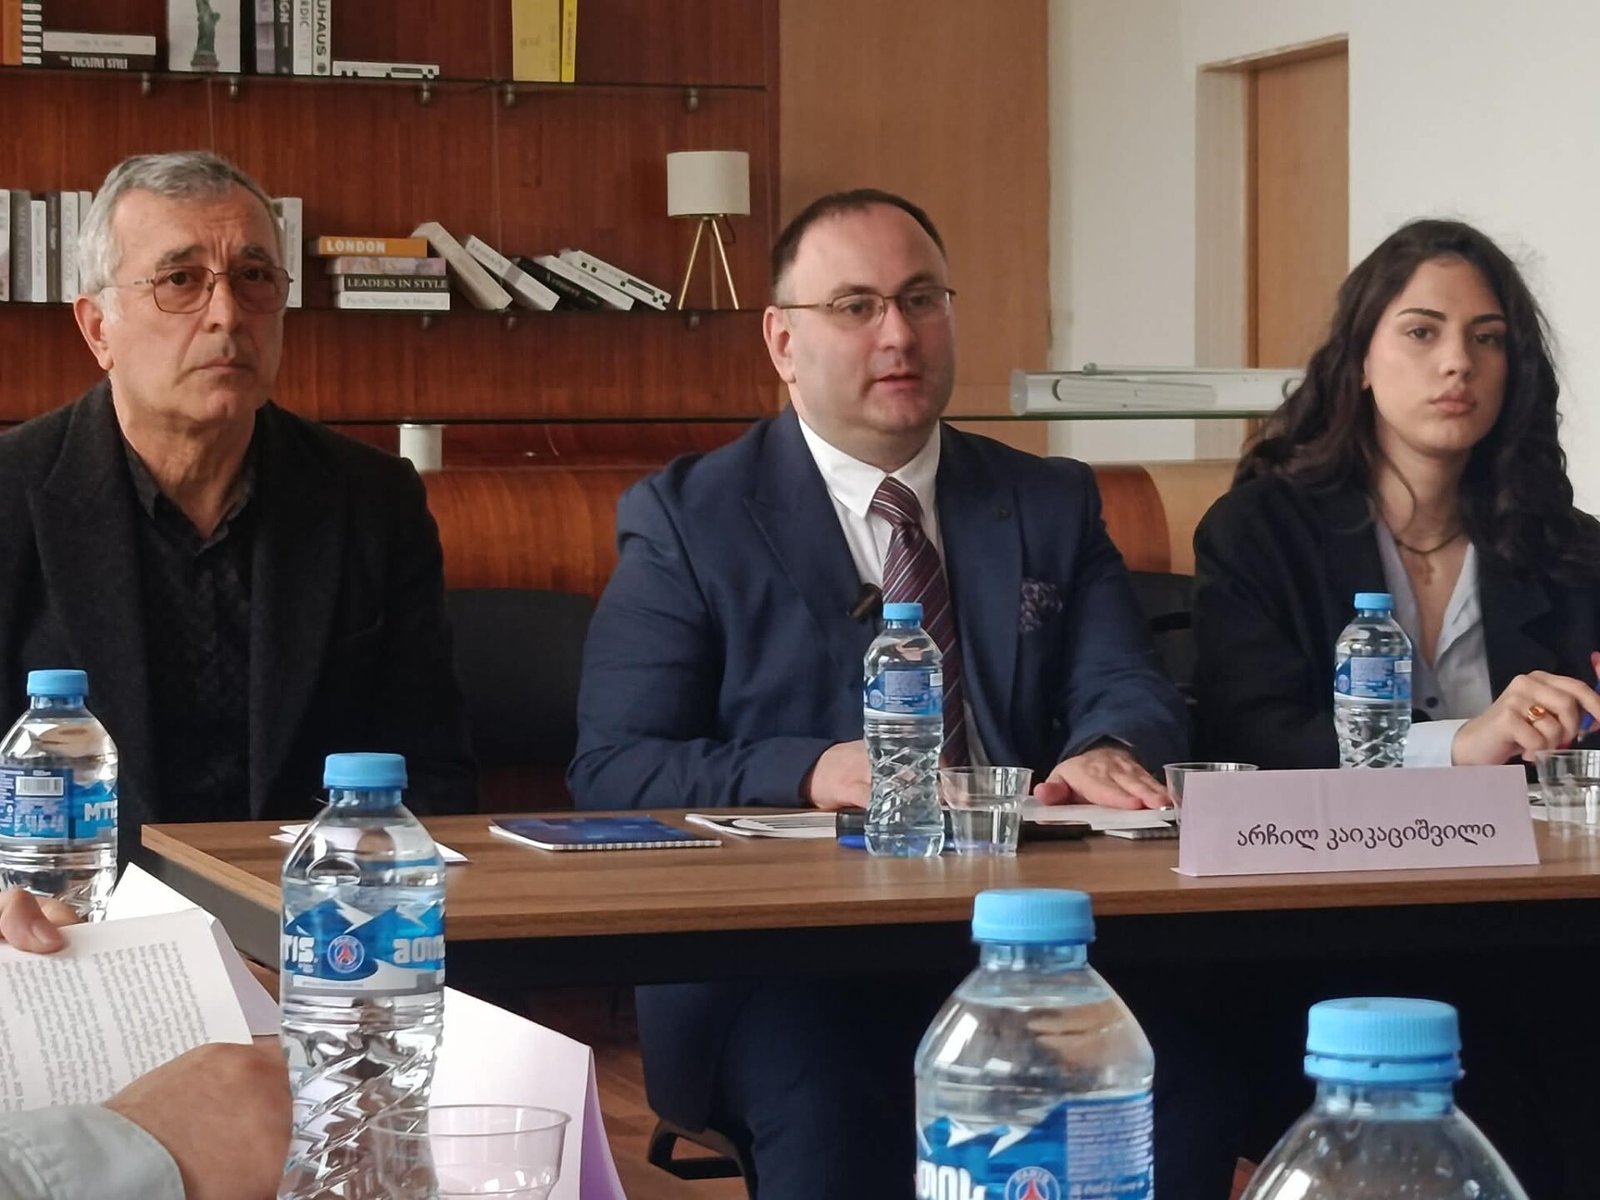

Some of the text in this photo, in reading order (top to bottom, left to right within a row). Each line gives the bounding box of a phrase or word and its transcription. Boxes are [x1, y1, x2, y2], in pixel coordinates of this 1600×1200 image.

[326, 240, 386, 254] LONDON
[347, 278, 447, 289] LEADERS IN STYLE
[1236, 818, 1496, 851] არჩილ კაიკაციშვილი
